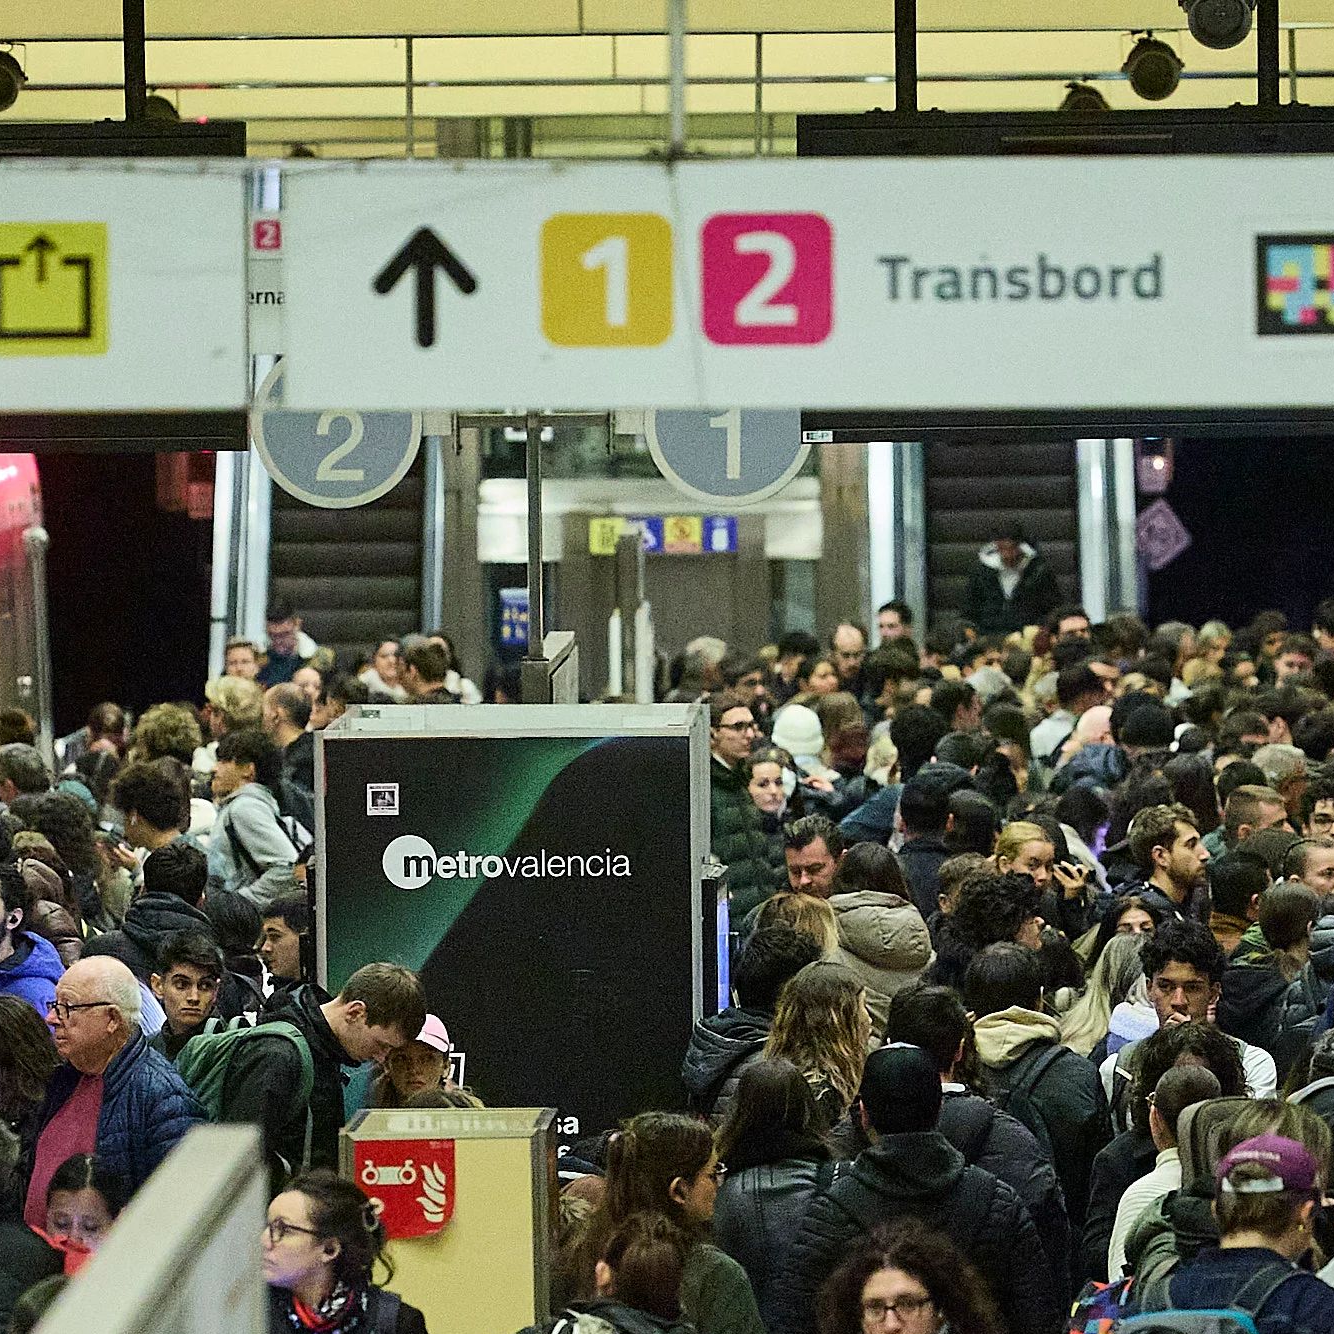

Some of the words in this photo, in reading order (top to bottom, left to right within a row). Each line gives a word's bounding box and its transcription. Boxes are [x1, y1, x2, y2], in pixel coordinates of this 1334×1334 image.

[580, 234, 629, 327] 1
[733, 230, 798, 326] 2
[877, 252, 1164, 301] Transbord
[315, 409, 365, 482] 2
[708, 409, 742, 480] 1
[403, 847, 632, 879] metrovalencia
